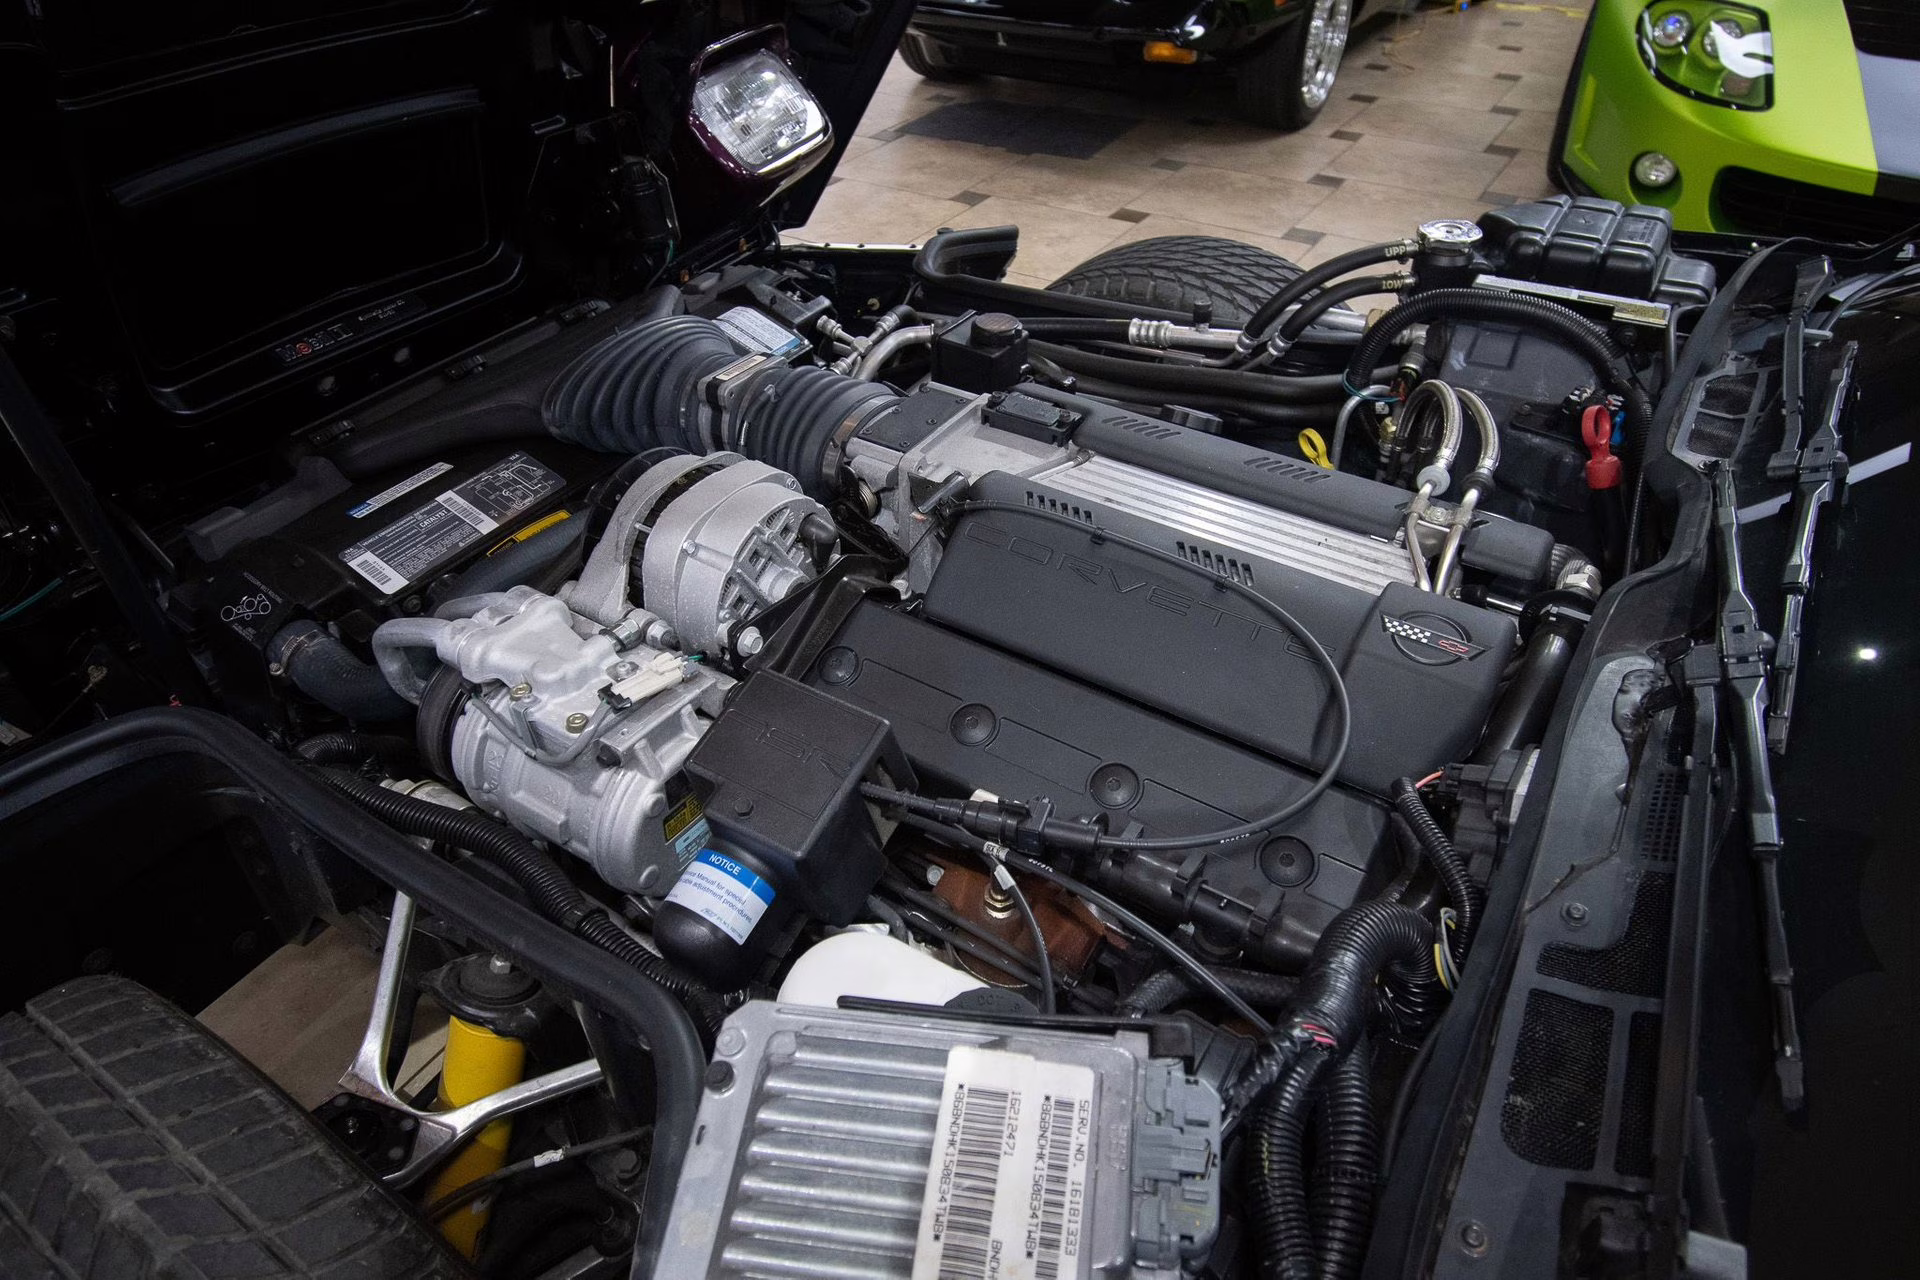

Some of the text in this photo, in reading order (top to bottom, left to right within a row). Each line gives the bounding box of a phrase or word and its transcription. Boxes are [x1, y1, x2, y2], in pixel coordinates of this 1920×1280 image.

[418, 509, 449, 527] CATALYST
[965, 521, 1336, 664] CORVETTE
[697, 872, 716, 885] Manual
[717, 883, 726, 891] for
[708, 854, 741, 876] NOTICE
[1004, 1090, 1022, 1157] 16212471
[1065, 1181, 1082, 1257] 16181333
